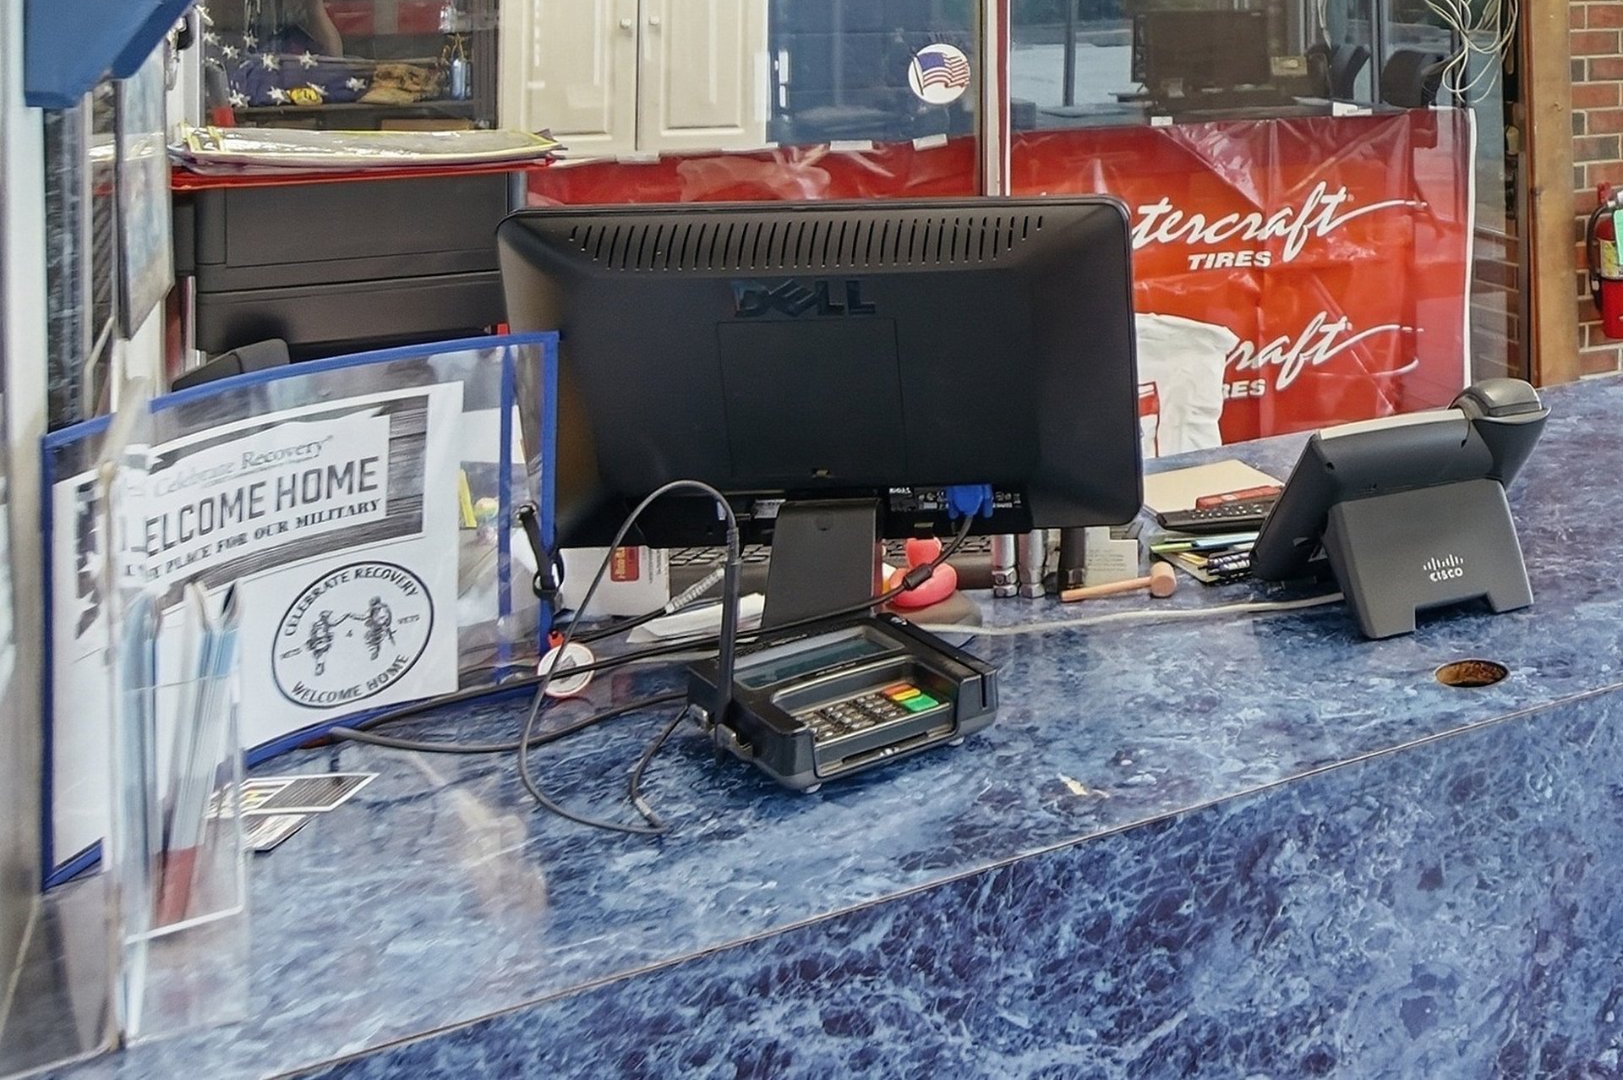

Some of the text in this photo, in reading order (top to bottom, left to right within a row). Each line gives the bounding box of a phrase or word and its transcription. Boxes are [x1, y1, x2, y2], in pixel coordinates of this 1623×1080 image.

[1188, 250, 1271, 270] TIRES
[731, 278, 876, 318] DELL
[1223, 378, 1265, 399] RES
[275, 456, 379, 512] HOME
[254, 521, 289, 540] OUR
[296, 498, 381, 529] MILITARY
[284, 567, 419, 637] CELEBRATE RECOVERY
[292, 654, 409, 704] WELCOME HOME
